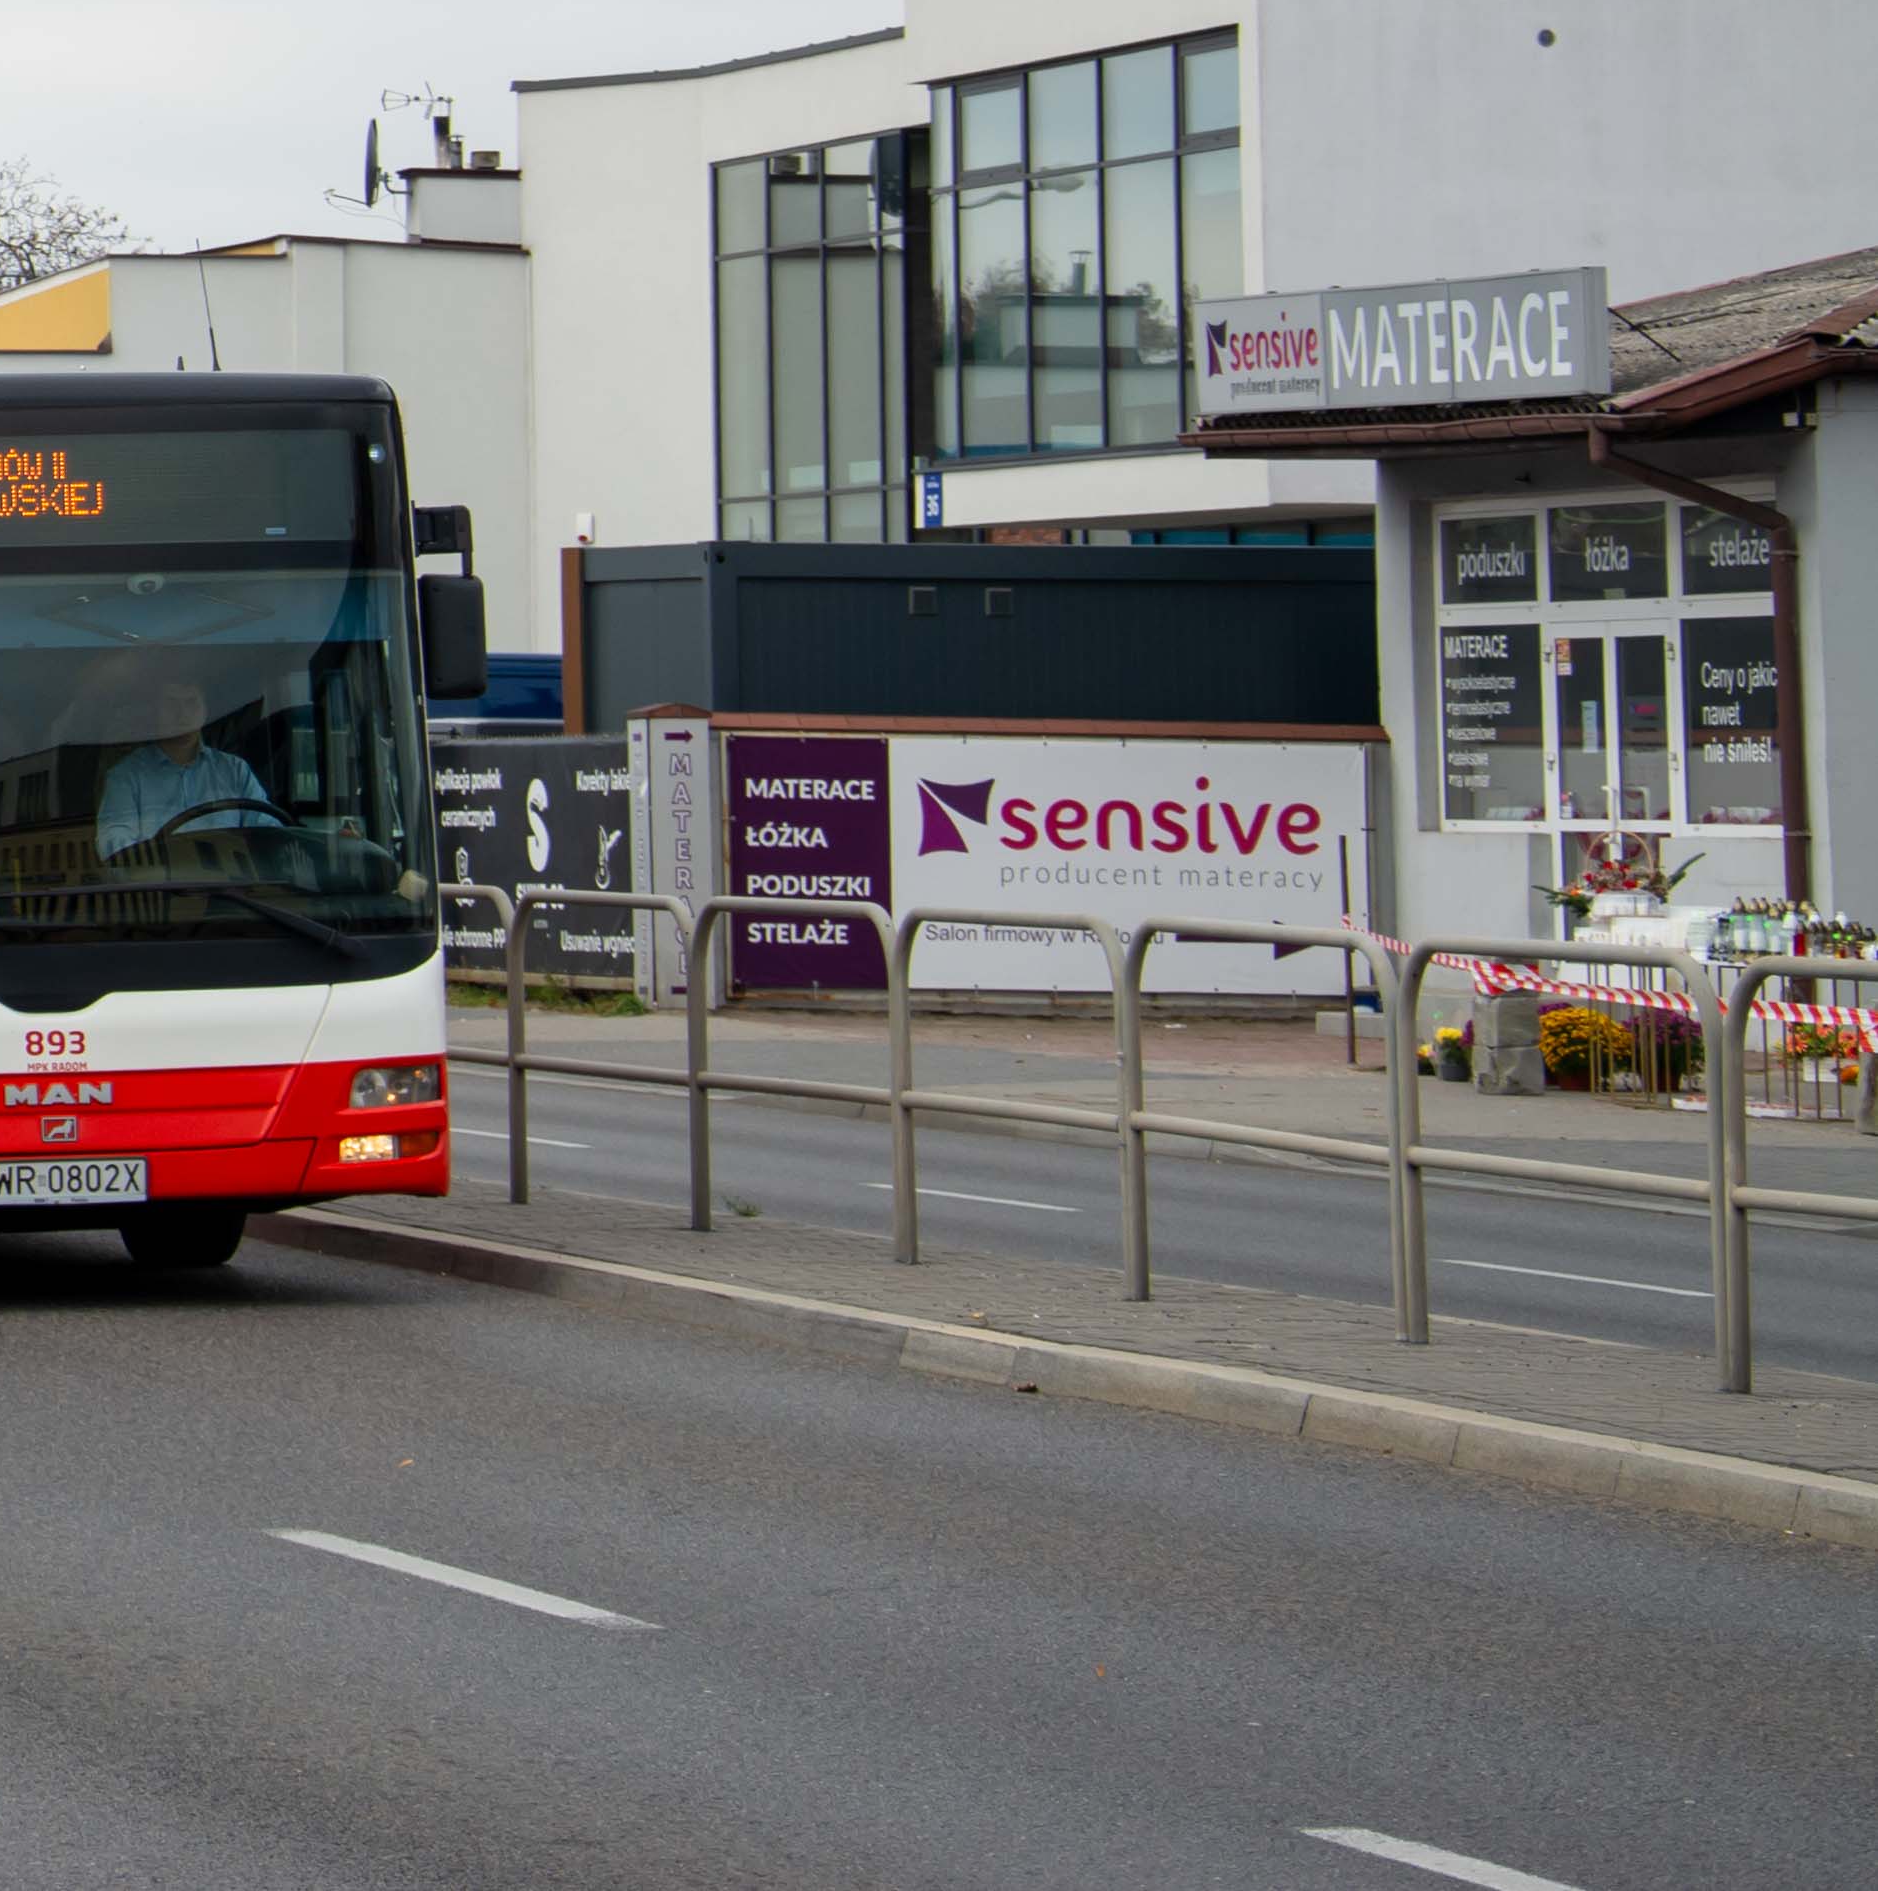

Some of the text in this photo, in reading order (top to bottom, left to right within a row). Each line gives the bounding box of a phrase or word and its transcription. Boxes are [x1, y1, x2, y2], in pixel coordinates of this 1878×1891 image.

[1229, 311, 1320, 373] sensive
[1328, 290, 1573, 390] MATERACE
[52, 450, 66, 480] II
[1585, 535, 1630, 572] łóżka
[1709, 528, 1771, 568] stelaże
[1457, 541, 1526, 585] poduszki
[1444, 635, 1509, 658] MATERACE
[1700, 661, 1735, 695] Ceny
[1737, 667, 1746, 688] o
[1702, 701, 1742, 726] nawet
[1704, 736, 1725, 764] nie
[576, 768, 609, 796] Korekty
[745, 777, 876, 801] MATERACE
[999, 776, 1322, 856] sensive
[745, 821, 829, 849] ŁÓŻKA
[746, 874, 872, 897] PODUSZKI
[1000, 862, 1324, 892] producent materacy
[560, 928, 603, 952] Usuwanie
[747, 918, 850, 946] STELAŻE
[925, 924, 978, 942] Salon
[984, 924, 1056, 947] firmowy
[1061, 931, 1077, 943] w
[25, 1030, 86, 1056] 893
[27, 1062, 88, 1072] MPK RADOM
[4, 1082, 114, 1106] MAN
[48, 1164, 140, 1193] 0802X
